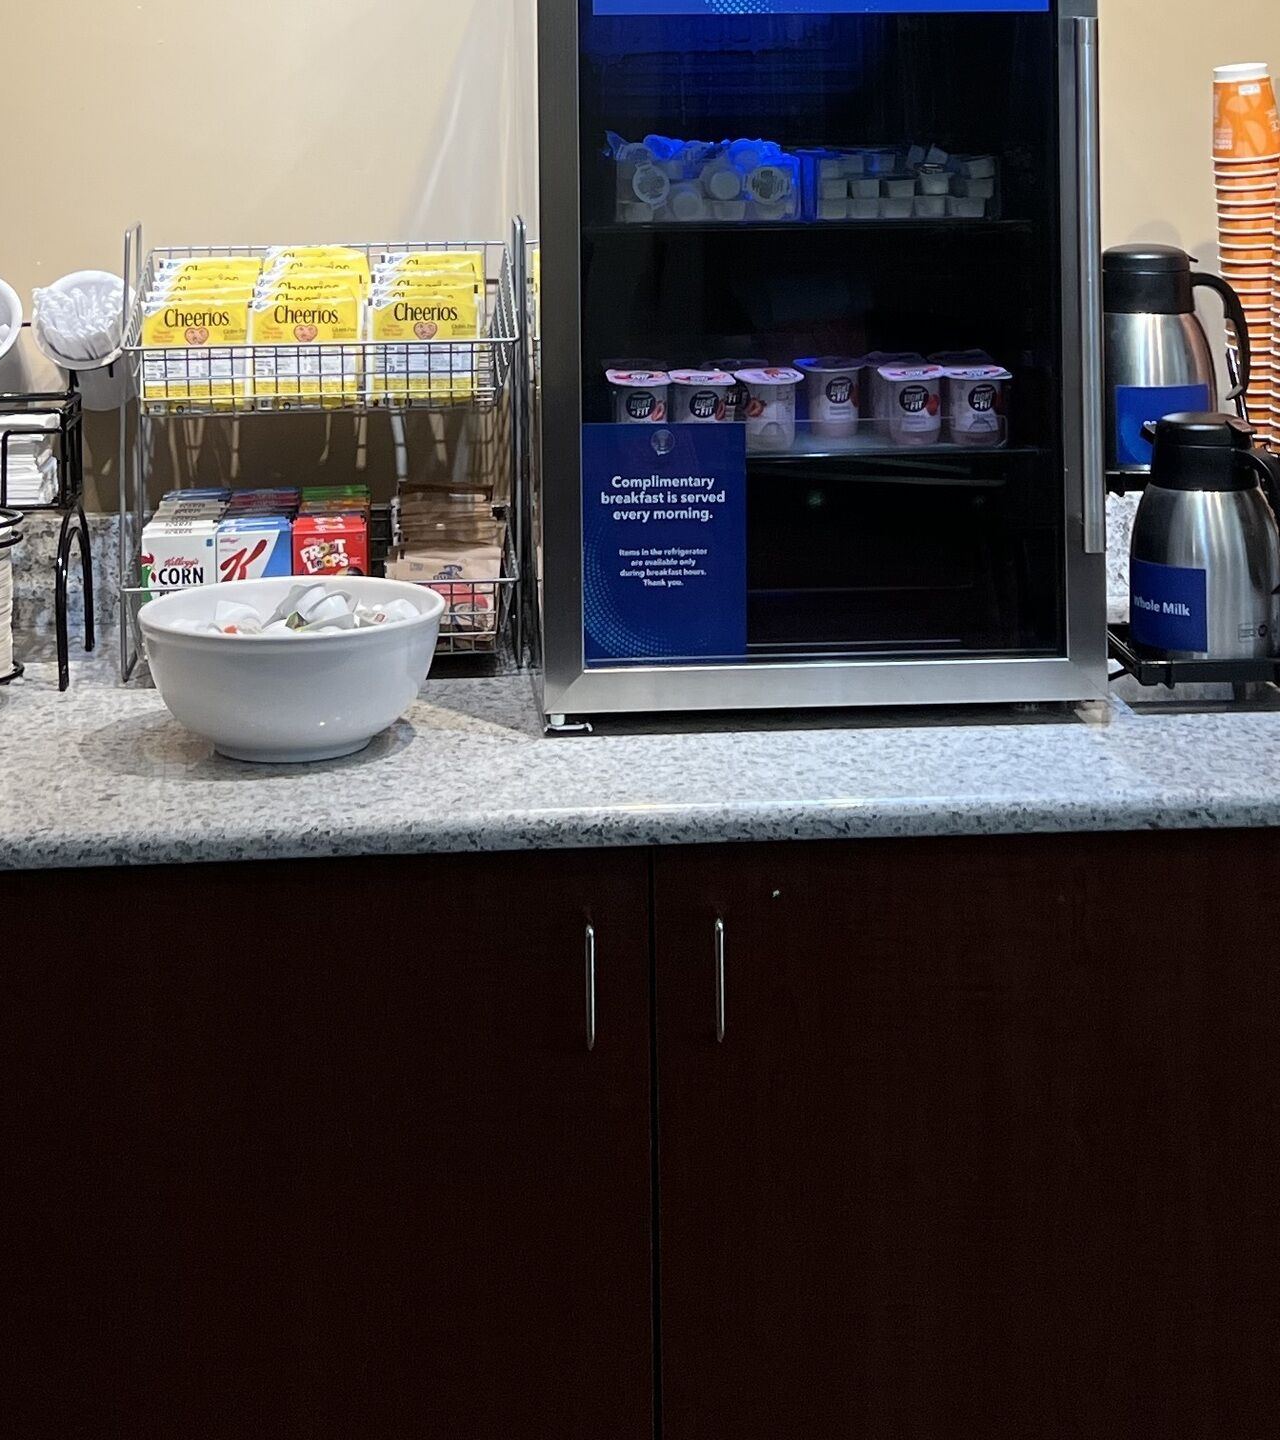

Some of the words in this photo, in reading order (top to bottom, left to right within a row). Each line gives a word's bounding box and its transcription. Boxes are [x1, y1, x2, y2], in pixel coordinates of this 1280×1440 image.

[163, 308, 230, 328] Cheerios
[273, 304, 339, 325] Cheerios
[393, 302, 458, 322] Cheerios
[611, 475, 715, 491] Complimentary
[601, 491, 665, 505] breakfast
[667, 491, 678, 503] is
[680, 490, 726, 503] served
[612, 510, 651, 523] every
[653, 507, 714, 522] morning.
[300, 539, 347, 564] FROOT
[641, 548, 650, 556] in
[650, 548, 663, 556] the
[664, 547, 708, 557] refrigerator
[164, 557, 199, 569] Kellogg's
[220, 539, 268, 583] K
[306, 552, 349, 575] LOOPS
[680, 558, 697, 567] only
[159, 567, 204, 585] CORN
[620, 569, 646, 578] during
[646, 568, 683, 577] breakfast
[642, 579, 667, 587] Thank
[1162, 601, 1191, 617] Milk
